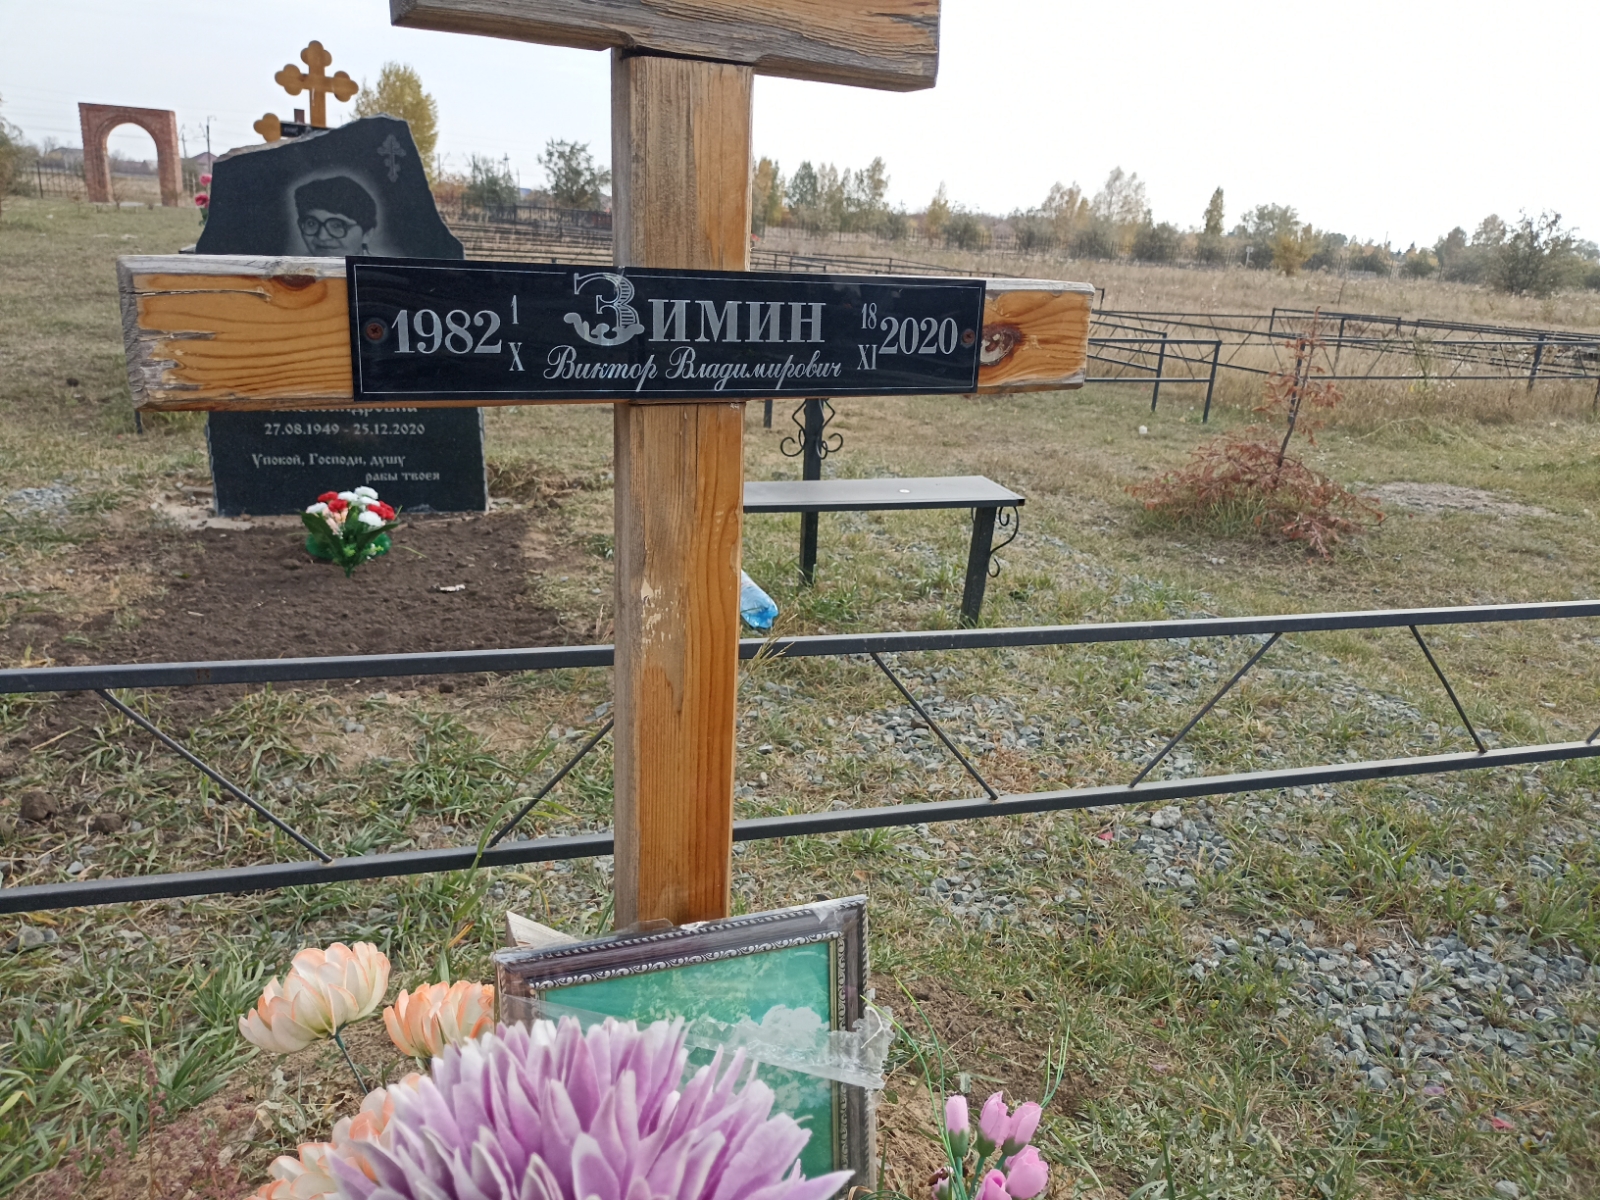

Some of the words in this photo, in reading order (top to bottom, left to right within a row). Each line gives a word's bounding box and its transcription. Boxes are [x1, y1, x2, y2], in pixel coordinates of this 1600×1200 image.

[511, 294, 520, 325] 1
[861, 302, 878, 330] 18
[391, 309, 503, 354] 1982
[878, 316, 959, 355] 2020
[543, 344, 659, 392] Виктор
[665, 345, 842, 392] Владимирович
[264, 422, 340, 436] 27.08.1949
[353, 422, 426, 436] 25.12.2020
[252, 453, 305, 469] Упокой,
[308, 452, 367, 467] Господи,
[370, 454, 406, 468] душу
